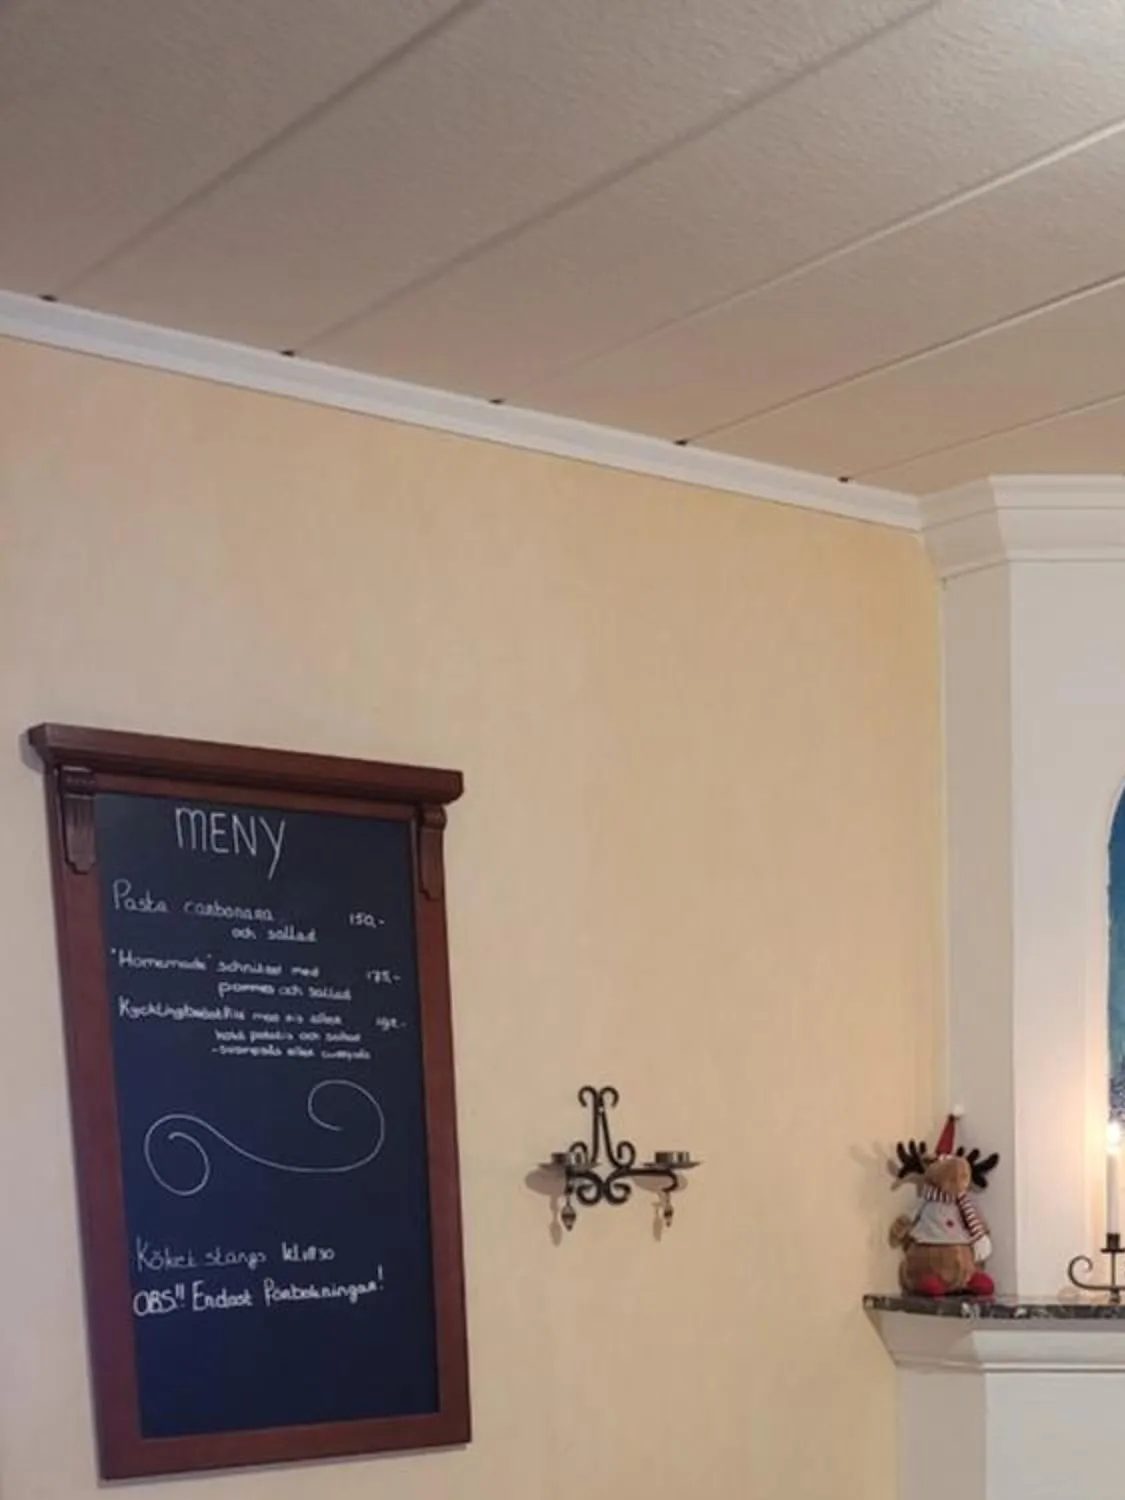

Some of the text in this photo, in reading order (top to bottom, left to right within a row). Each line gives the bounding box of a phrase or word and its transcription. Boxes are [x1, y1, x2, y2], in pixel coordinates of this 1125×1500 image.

[175, 806, 286, 881] MENY
[112, 879, 168, 913] Pasta
[231, 926, 257, 940] och
[192, 1280, 254, 1312] Endast
